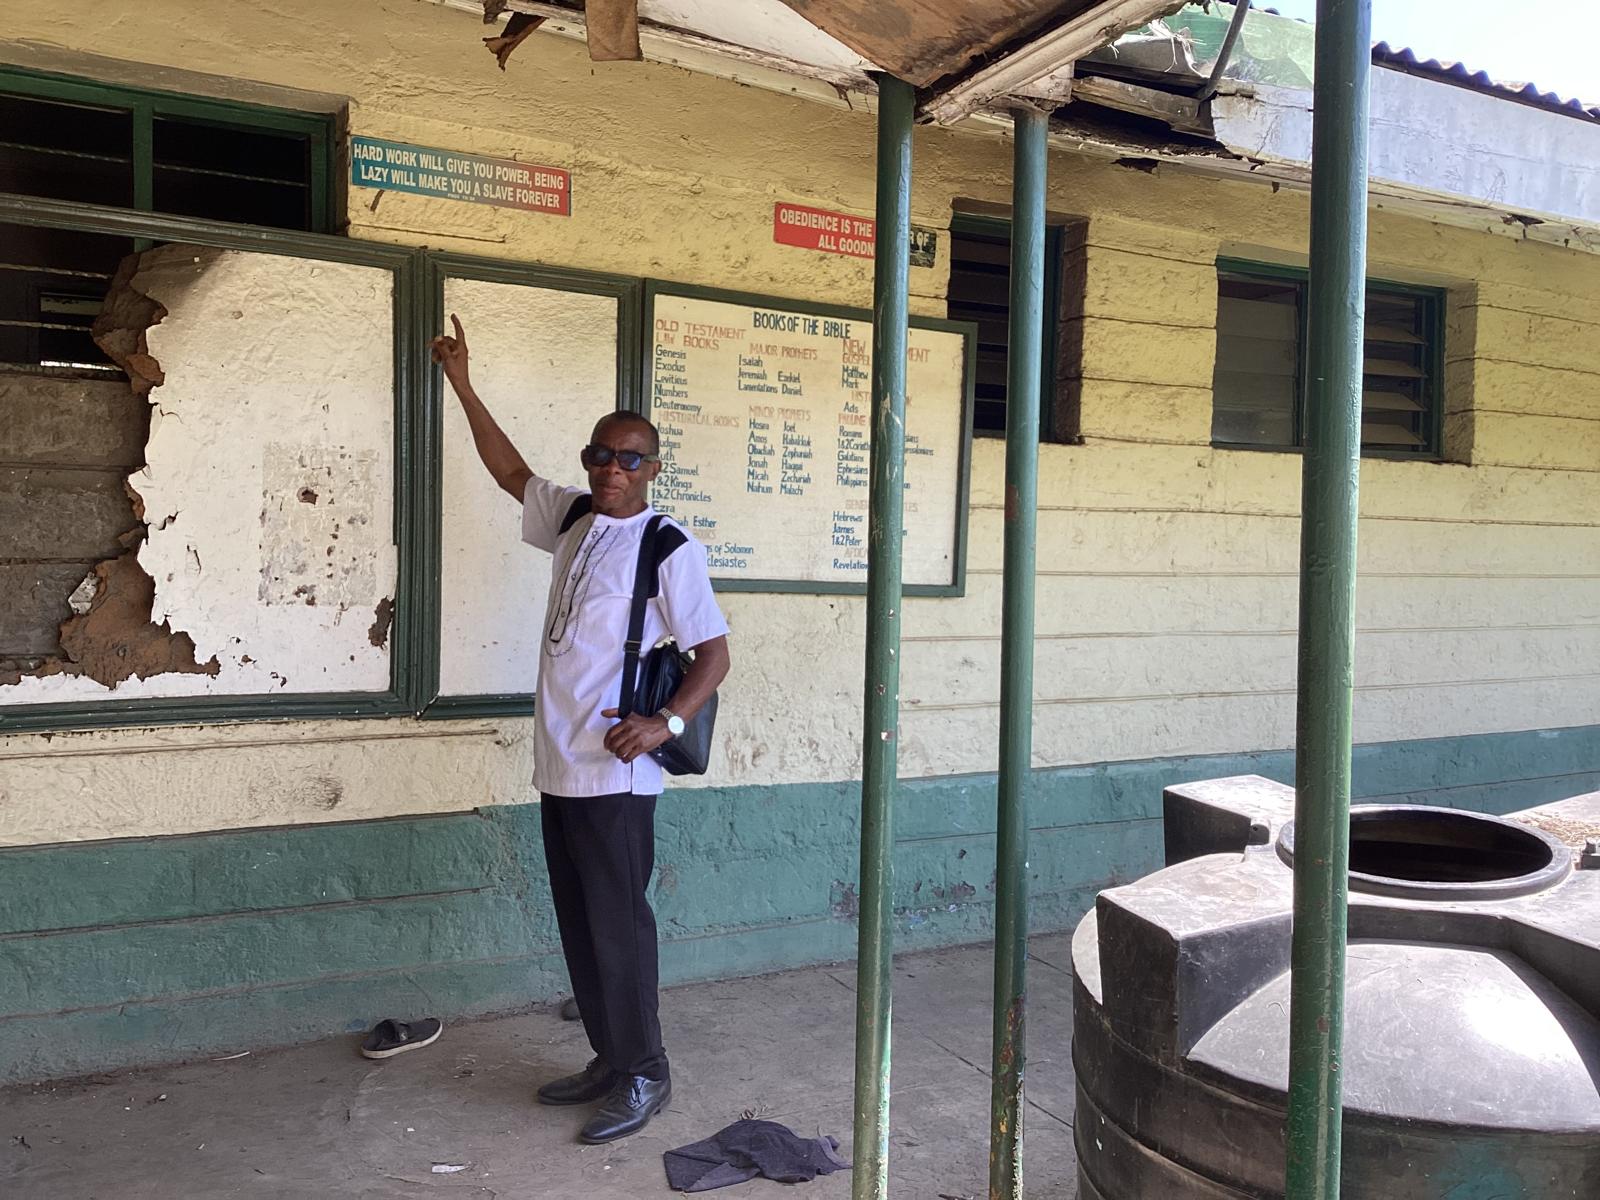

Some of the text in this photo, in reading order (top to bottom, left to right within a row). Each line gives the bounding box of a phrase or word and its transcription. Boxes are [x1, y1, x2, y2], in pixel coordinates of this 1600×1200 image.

[354, 143, 564, 190] HARD WORK WILL GIVE YOU POWER, BEING
[361, 164, 389, 183] LAZY
[391, 169, 416, 187] WILL
[418, 173, 448, 191] MAKE
[450, 178, 471, 195] YOU
[473, 182, 481, 197] A
[483, 183, 514, 201] SLAVE
[516, 188, 560, 208] FOREVER
[780, 208, 873, 237] OBEDIENCE IS THE
[818, 234, 875, 256] ALL GOODN
[655, 319, 747, 340] OLD TESTAMENT
[753, 311, 851, 339] BOOKS OF THE BIBLE
[683, 335, 720, 351] BOOKS
[842, 339, 866, 354] NEW
[655, 344, 687, 360] Genesis
[655, 357, 686, 372] Exodus
[738, 354, 763, 367] Isaiah
[781, 383, 802, 396] Daniel
[841, 377, 859, 389] Mark
[654, 384, 689, 399] Numbers
[659, 436, 681, 449] udges
[660, 448, 675, 461] uth
[747, 455, 768, 469] Jonah
[747, 467, 769, 481] Micah
[747, 481, 773, 494] Nahum
[651, 501, 676, 513] Ezra
[693, 515, 717, 528] Esther
[832, 510, 864, 523] Hebrews
[832, 522, 855, 534] James
[724, 542, 754, 555] Solomon
[706, 554, 747, 568] clesiastes
